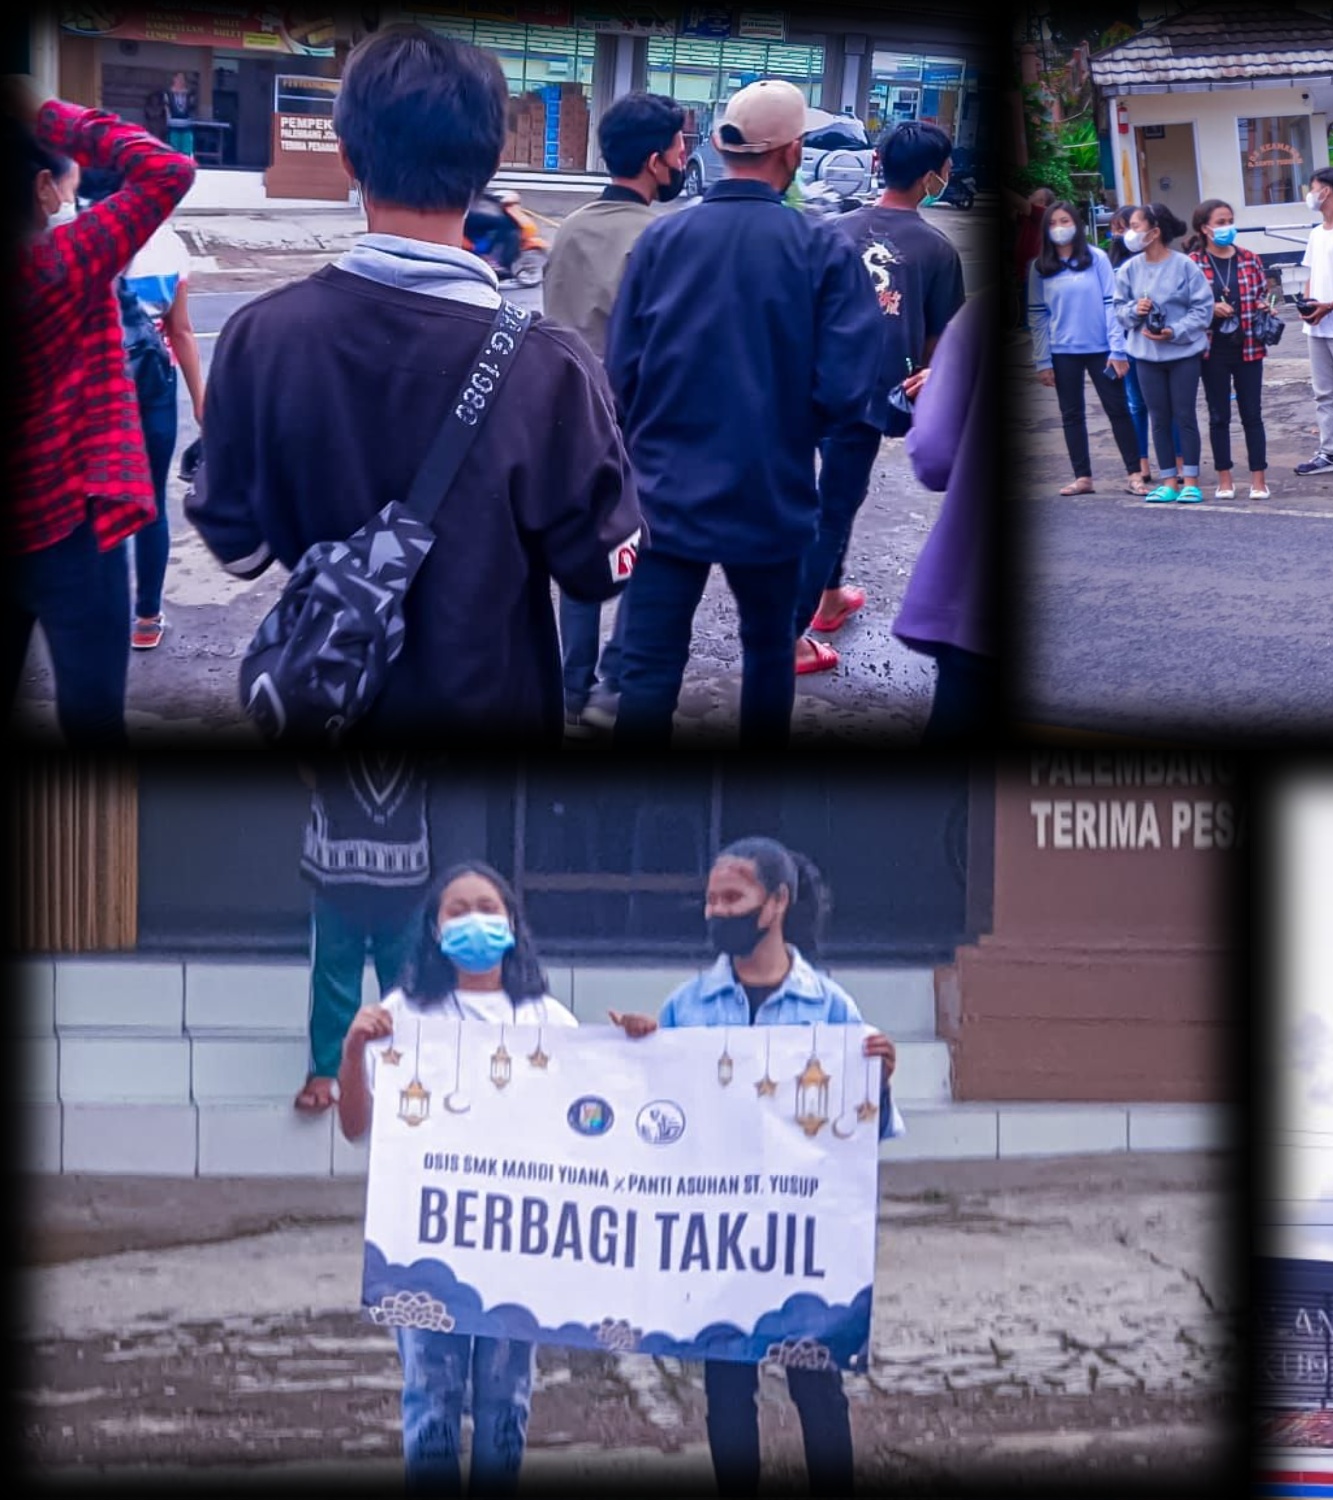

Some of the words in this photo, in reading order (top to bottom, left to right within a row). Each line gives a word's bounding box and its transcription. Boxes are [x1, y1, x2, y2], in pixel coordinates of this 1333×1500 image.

[281, 116, 334, 130] PEMPEK
[1030, 800, 1162, 850] TERIMA
[463, 1155, 498, 1177] SMK
[502, 1159, 554, 1184] MARDI
[558, 1165, 610, 1190] YUANA
[628, 1173, 672, 1196] PANTI
[676, 1173, 740, 1197] ASUHAN
[769, 1174, 819, 1198] YUSUP
[418, 1186, 638, 1269] BERBAGI
[654, 1211, 826, 1279] TAKJIL
